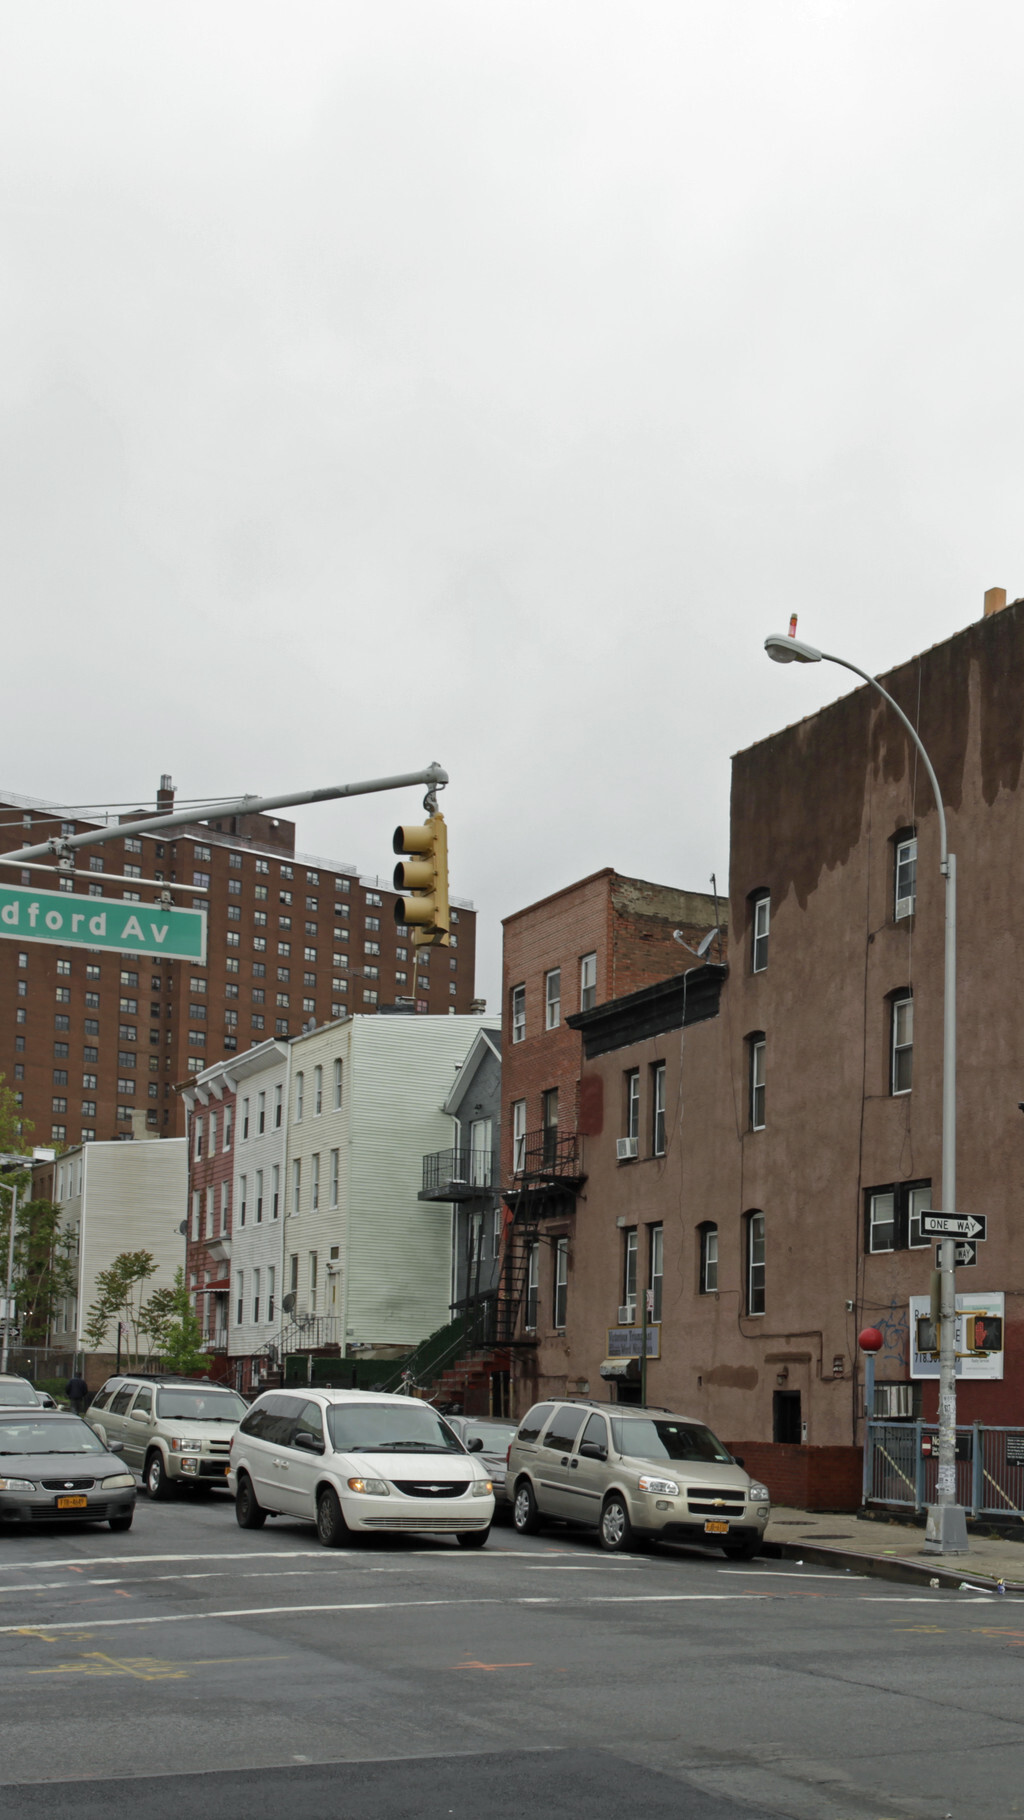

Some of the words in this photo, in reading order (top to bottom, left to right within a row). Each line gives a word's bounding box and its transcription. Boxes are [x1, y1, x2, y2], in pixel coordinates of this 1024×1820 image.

[1, 901, 107, 936] dford
[121, 915, 169, 943] Av
[930, 1219, 949, 1229] ONE
[957, 1221, 976, 1232] WAY
[958, 1248, 971, 1258] WAY
